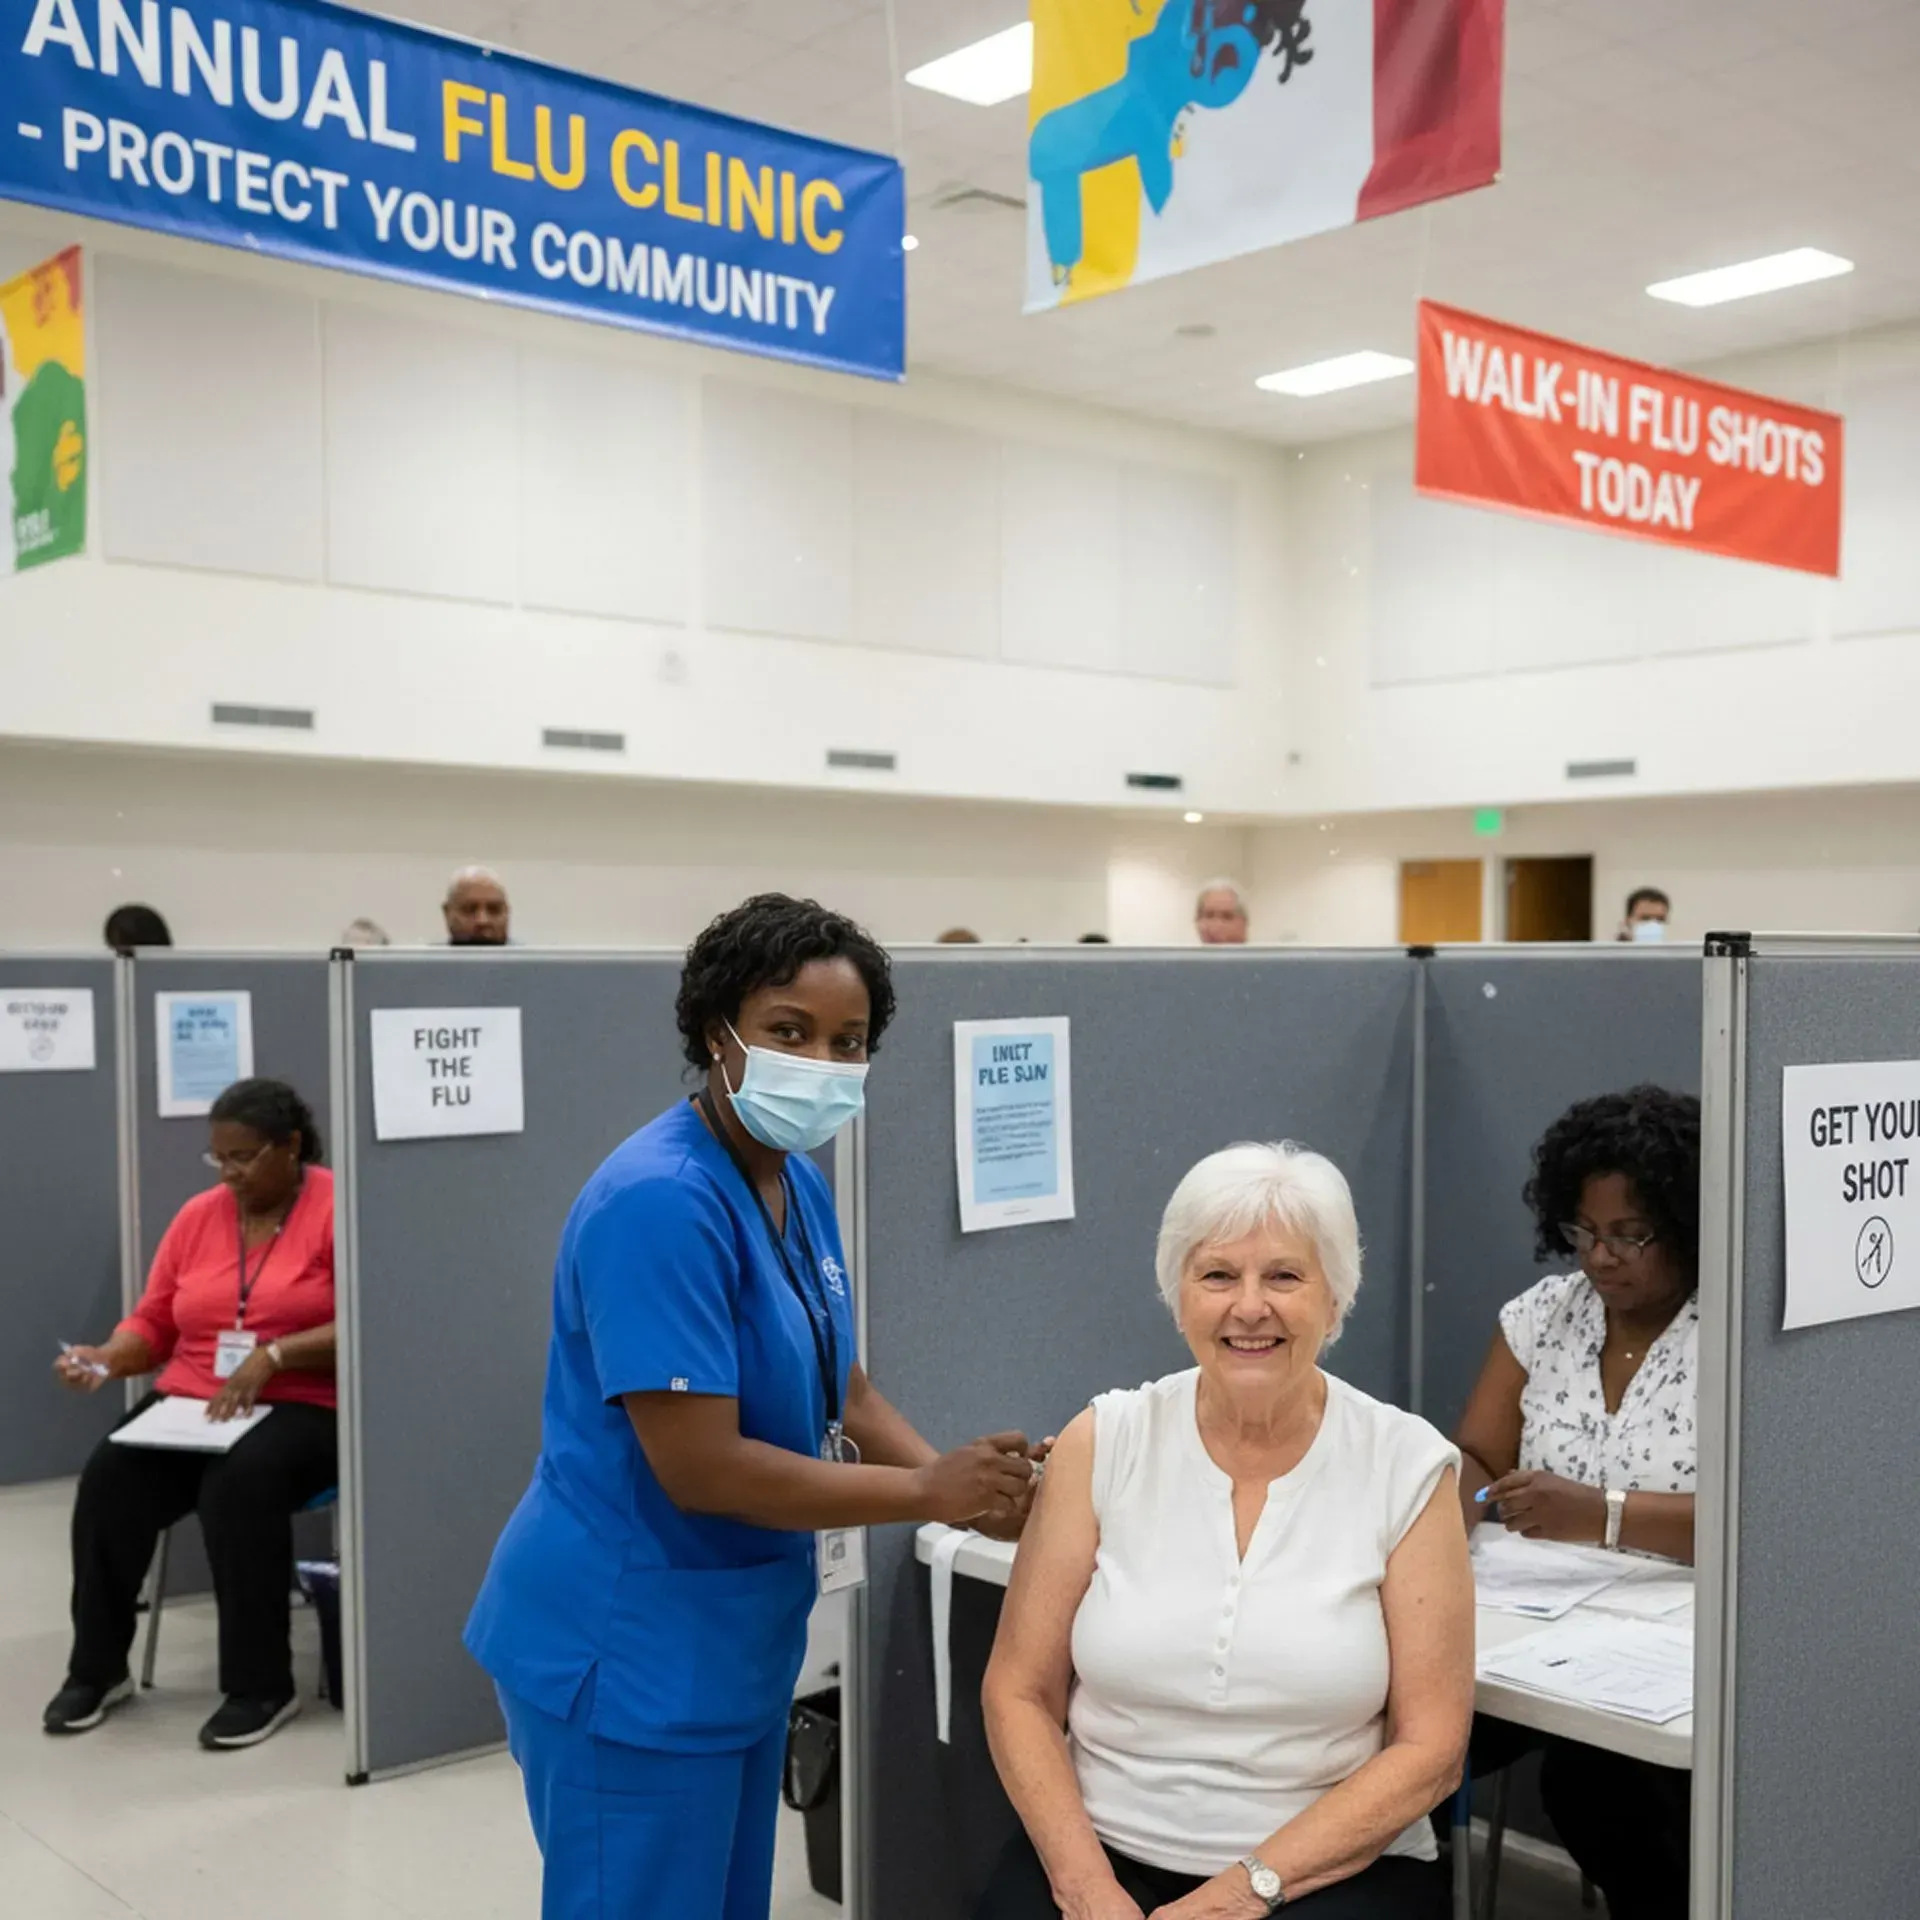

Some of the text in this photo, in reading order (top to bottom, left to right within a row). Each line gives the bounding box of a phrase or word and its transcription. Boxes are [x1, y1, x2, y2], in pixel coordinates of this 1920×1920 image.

[21, 0, 845, 254] ANNUAL FLU CLINIC
[17, 107, 835, 336] - PROTECT YOUR COMMUNITY
[1441, 329, 1825, 487] WALK-IN FLU SHOTS
[1572, 449, 1701, 531] TODAY
[413, 1026, 482, 1051] FIGHT
[426, 1055, 472, 1079] THE
[431, 1084, 472, 1108] FLU
[1809, 1099, 1920, 1148] GET YOU
[1842, 1157, 1910, 1203] SHOT
